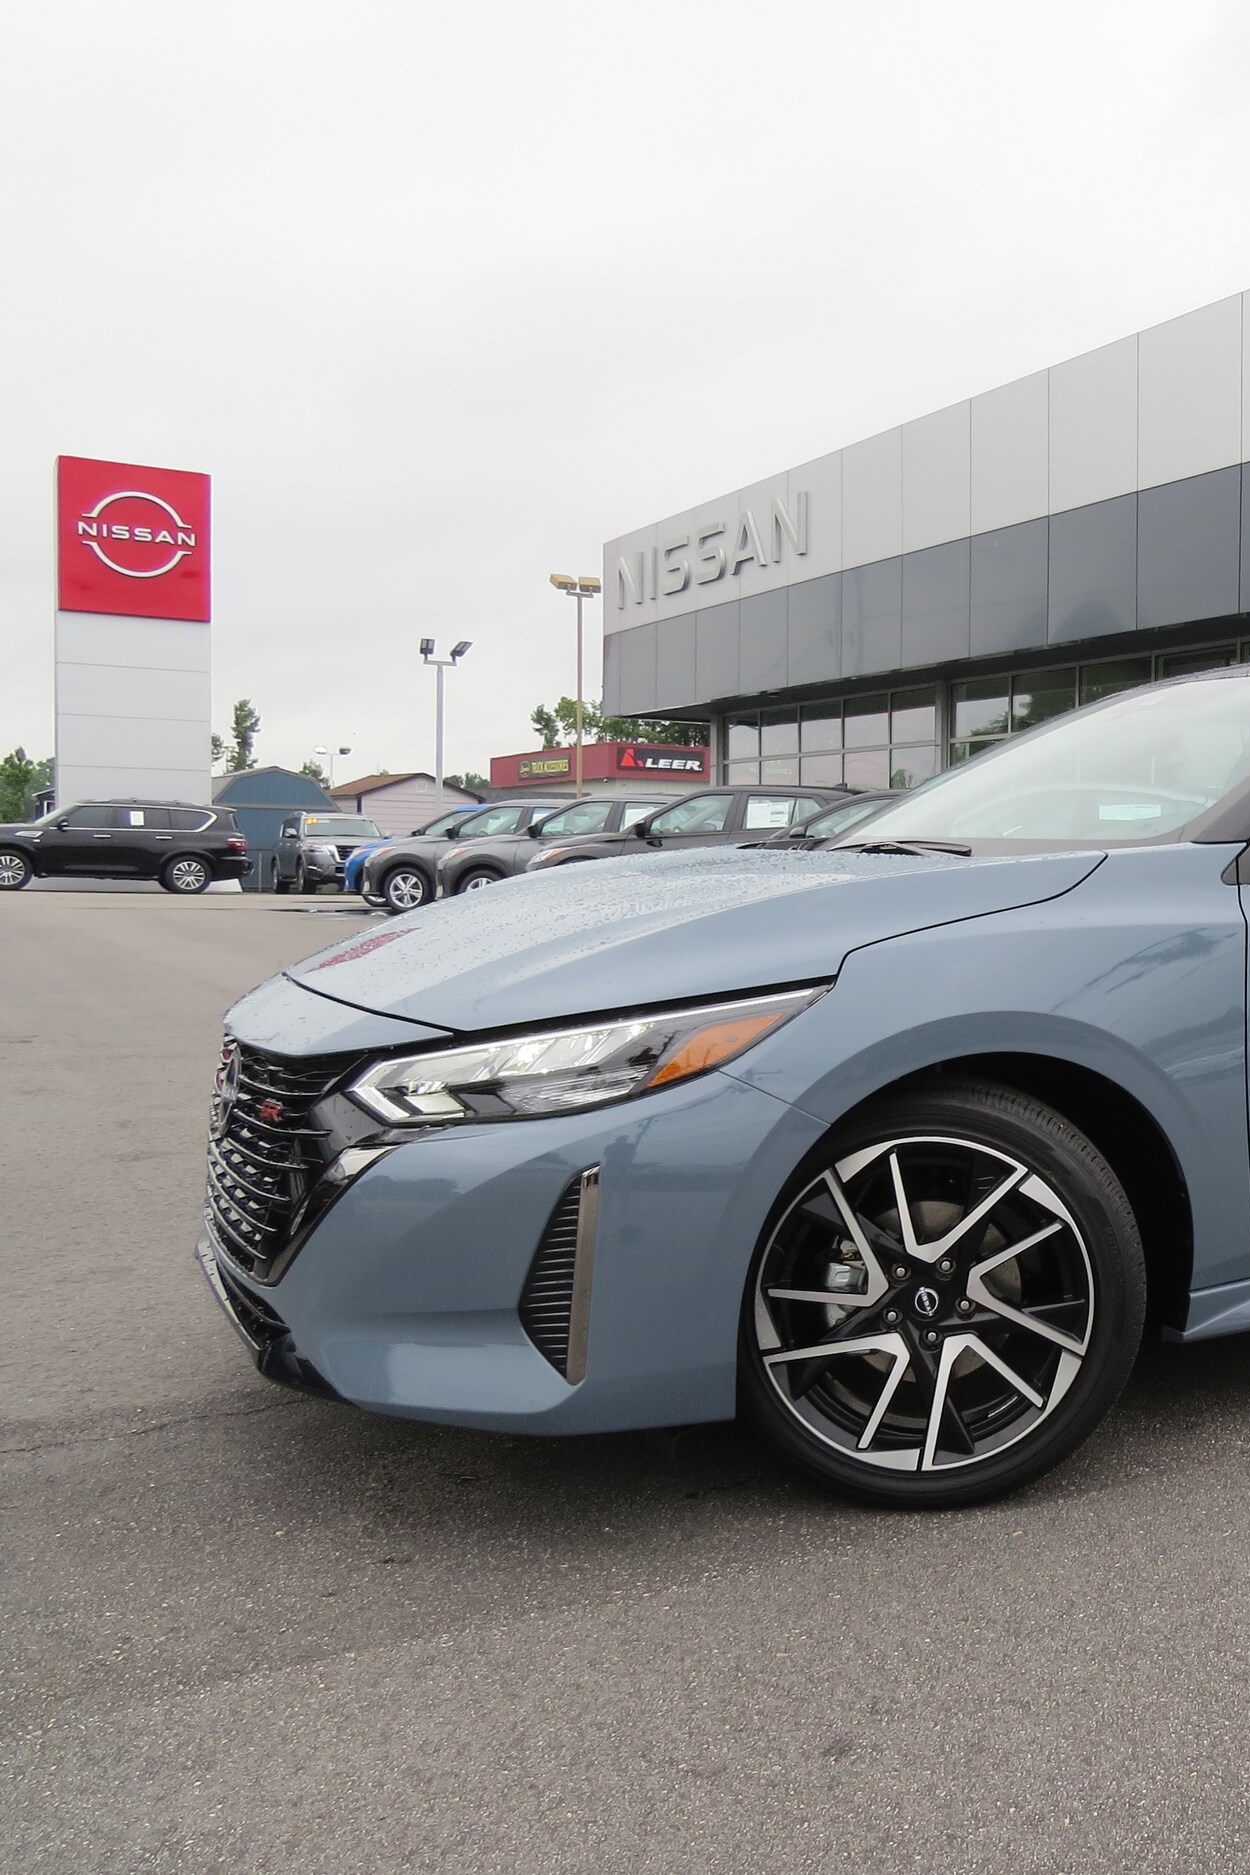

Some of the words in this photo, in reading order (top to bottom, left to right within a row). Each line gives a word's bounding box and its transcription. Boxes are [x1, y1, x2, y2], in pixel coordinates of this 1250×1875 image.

[77, 520, 196, 547] NISSAN
[616, 490, 808, 610] NISSAN
[644, 757, 702, 771] LEER
